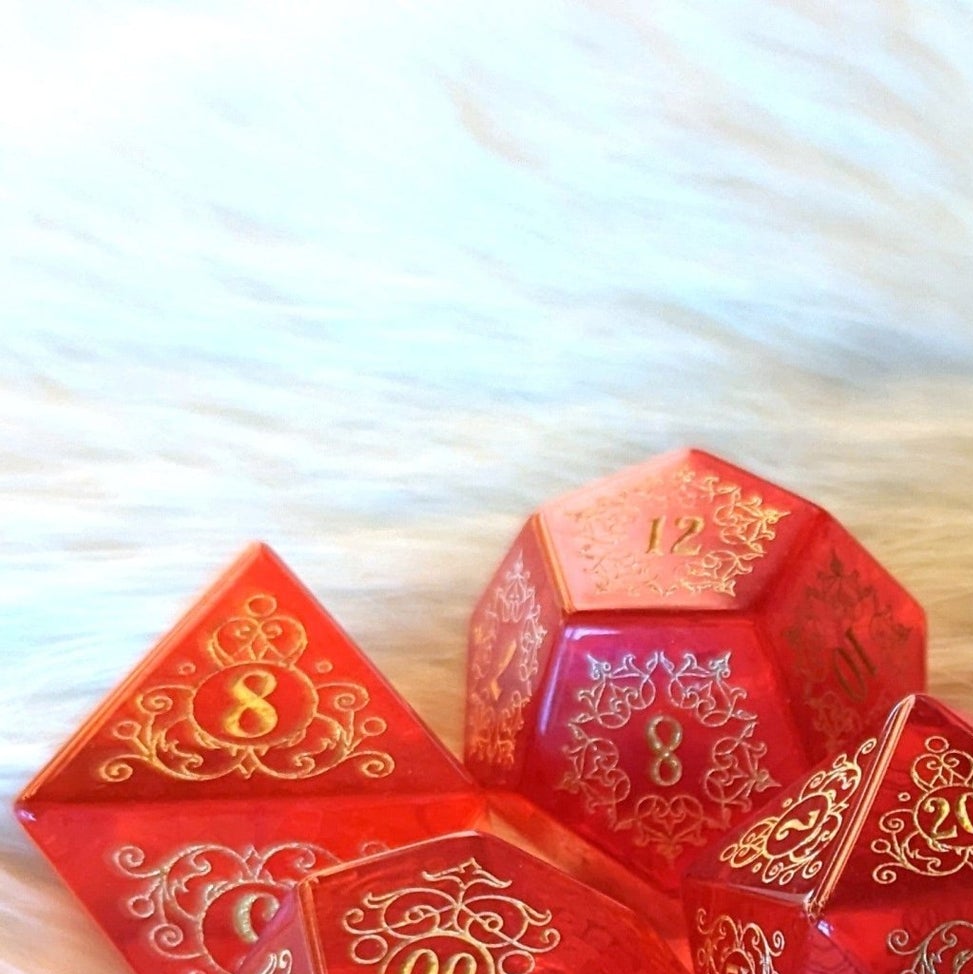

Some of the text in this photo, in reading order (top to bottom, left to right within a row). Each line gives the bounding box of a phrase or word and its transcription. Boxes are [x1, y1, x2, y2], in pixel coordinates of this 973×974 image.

[645, 516, 706, 556] 12
[224, 671, 279, 739] 8
[646, 715, 683, 788] 8
[774, 809, 820, 841] 2
